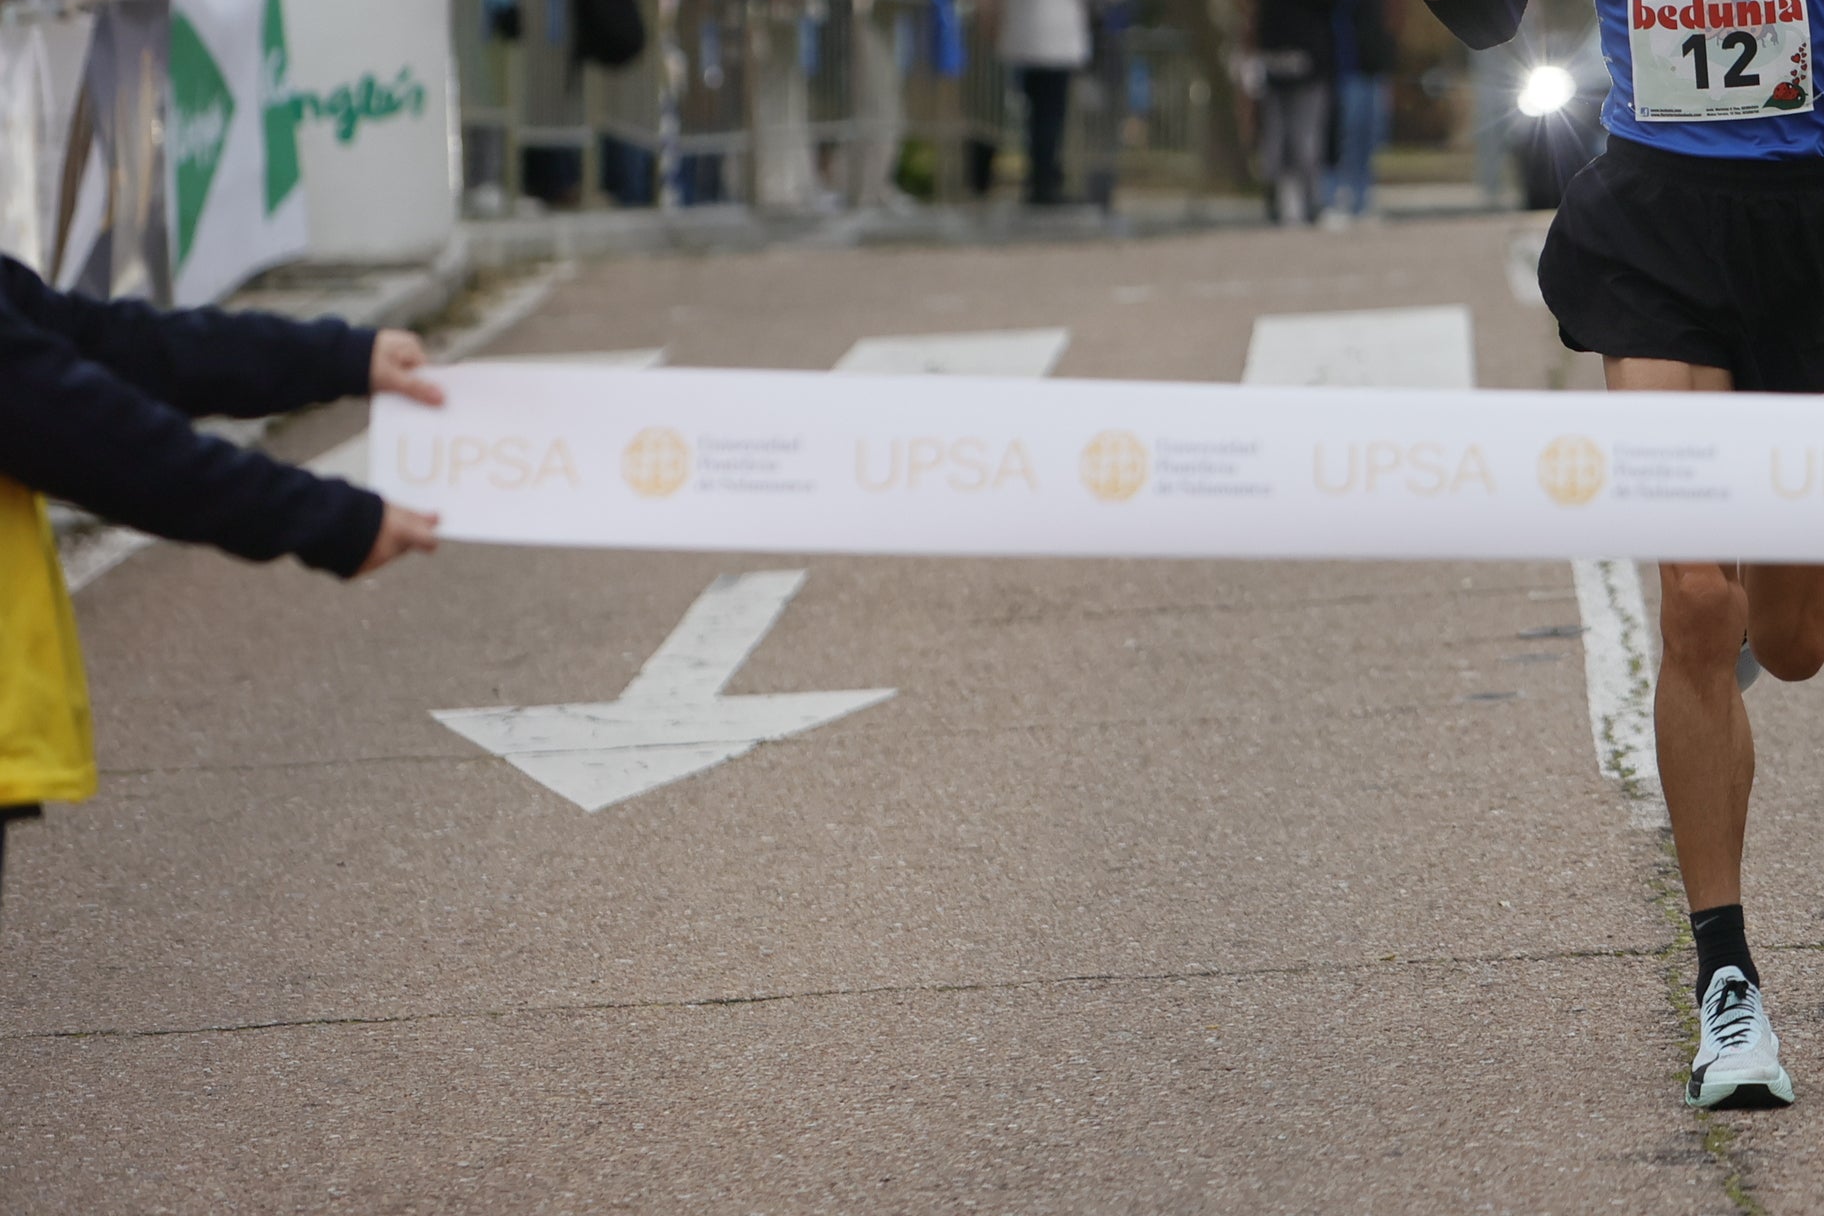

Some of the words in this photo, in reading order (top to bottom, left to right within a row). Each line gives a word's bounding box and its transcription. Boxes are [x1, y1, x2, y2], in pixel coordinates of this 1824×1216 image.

[1682, 31, 1760, 89] 12
[396, 433, 580, 490] UPSA
[853, 437, 1040, 494] UPSA
[1311, 440, 1496, 499] UPSA
